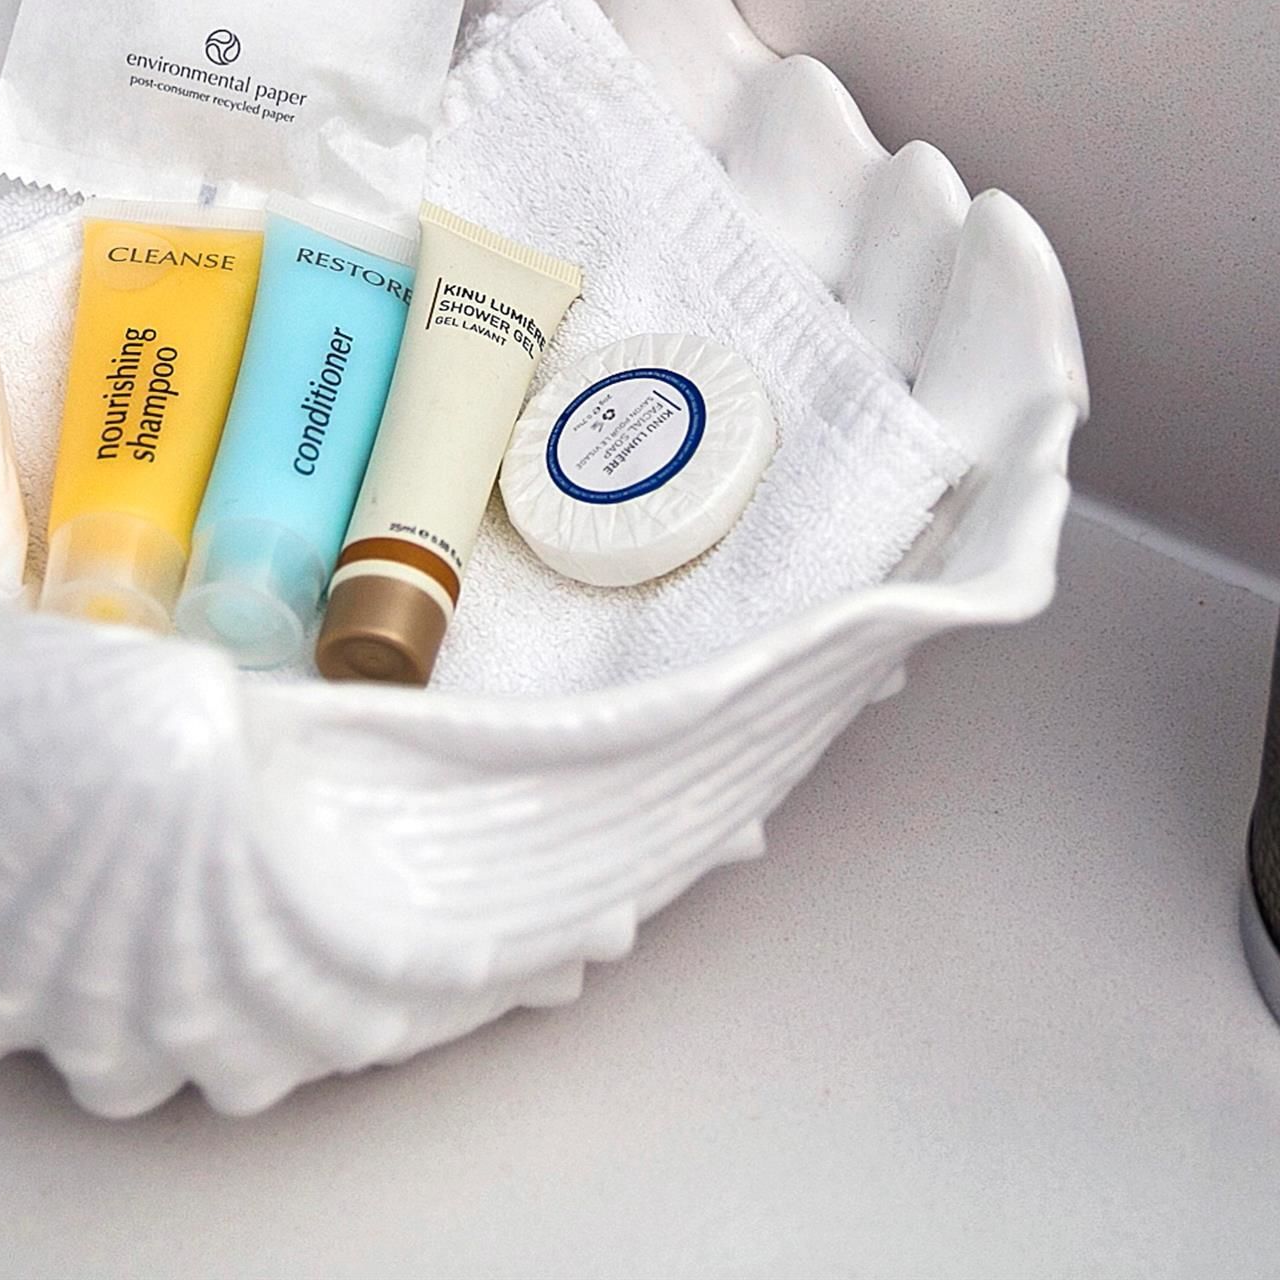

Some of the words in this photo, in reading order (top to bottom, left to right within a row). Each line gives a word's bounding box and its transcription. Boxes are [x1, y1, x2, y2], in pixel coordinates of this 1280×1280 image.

[126, 51, 252, 94] environmental
[254, 80, 308, 107] paper
[129, 73, 210, 103] post-consumer
[212, 94, 260, 115] recycled
[261, 106, 296, 124] paper
[107, 246, 236, 272] CLEANSE
[296, 247, 413, 306] RESTORE
[435, 315, 459, 327] GEL
[462, 320, 508, 346] LAVANT
[439, 300, 510, 334] SHOWER
[513, 329, 535, 360] GEL
[443, 284, 487, 304] KINU
[490, 297, 547, 352] LUMIÈRE
[95, 327, 158, 462] nourishing
[127, 345, 180, 463] shampoo
[292, 325, 356, 476] conditioner
[627, 401, 663, 431] FACIAL
[646, 408, 674, 433] KINU
[603, 432, 630, 459] SOAP
